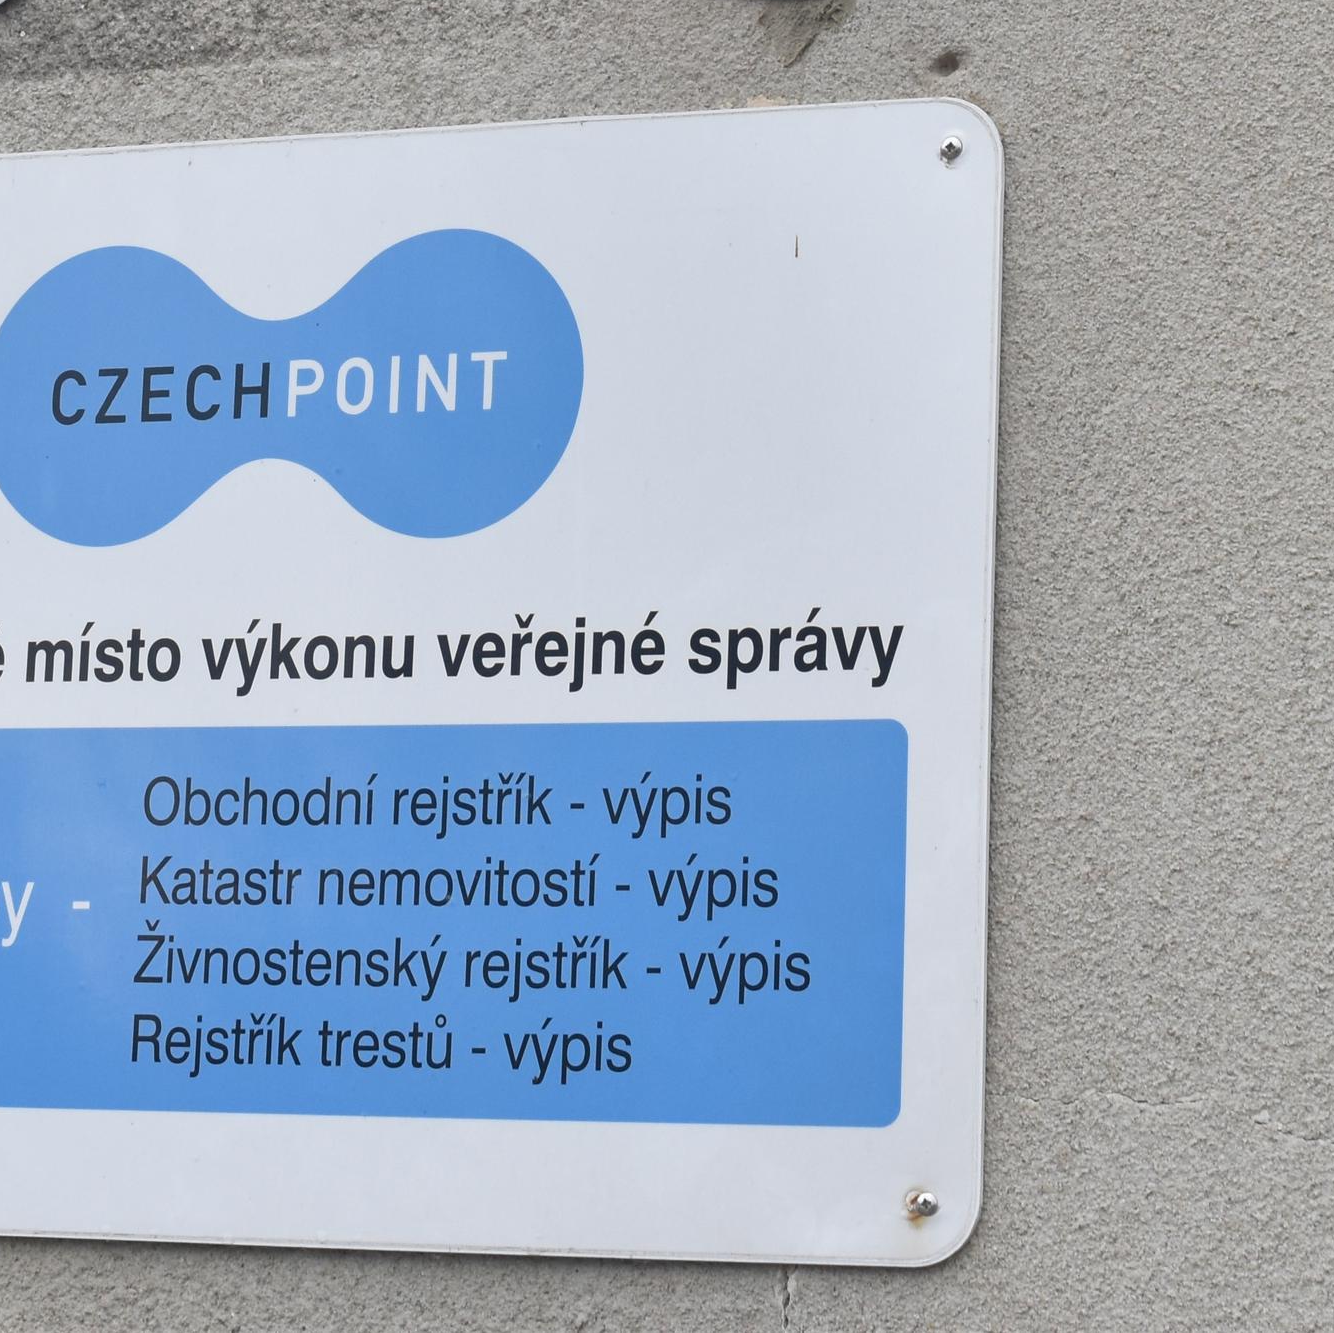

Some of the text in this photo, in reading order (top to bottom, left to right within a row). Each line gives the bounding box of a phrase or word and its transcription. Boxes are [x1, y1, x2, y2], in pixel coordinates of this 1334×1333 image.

[52, 350, 508, 426] CZECHPOINT
[25, 621, 181, 683] místo
[201, 618, 415, 697] výkonu
[437, 610, 666, 693] veřejné
[688, 607, 904, 690] správy
[144, 773, 378, 827] Obchodní
[393, 772, 552, 840] rejstřík
[602, 771, 732, 839] výpis
[140, 855, 302, 906] Katastr
[318, 853, 600, 908] nemovitostí
[648, 853, 779, 922] výpis
[133, 919, 448, 1001] Živnostenský
[464, 935, 628, 1003] rejstřík
[679, 936, 811, 1005] výpis
[131, 1013, 302, 1078] Rejstřík
[318, 1013, 453, 1070] trestů
[502, 1016, 633, 1085] výpis
